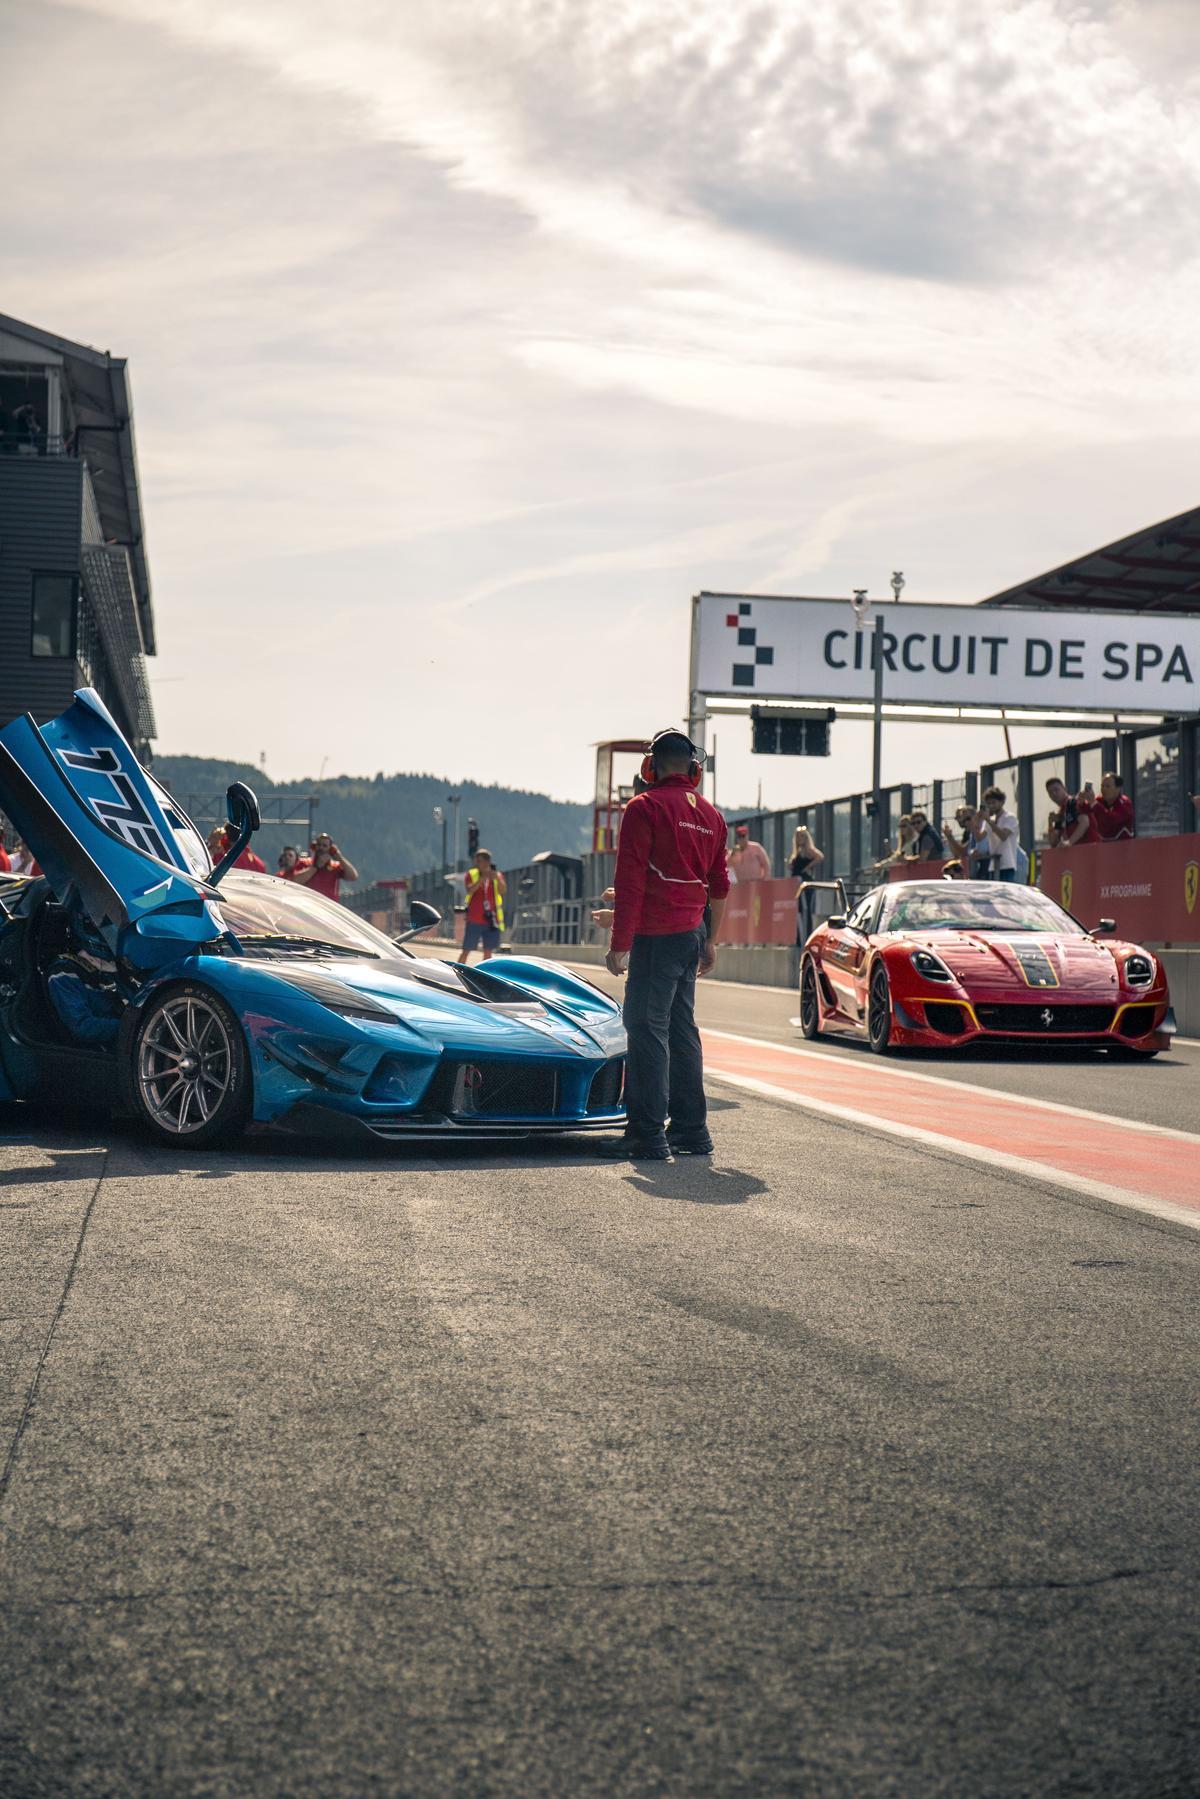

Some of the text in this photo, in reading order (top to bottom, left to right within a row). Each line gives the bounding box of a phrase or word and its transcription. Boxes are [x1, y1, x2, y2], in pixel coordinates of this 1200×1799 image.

[824, 629, 1194, 683] CIRCUIT DE SPA
[1110, 883, 1153, 898] PROGRAMME
